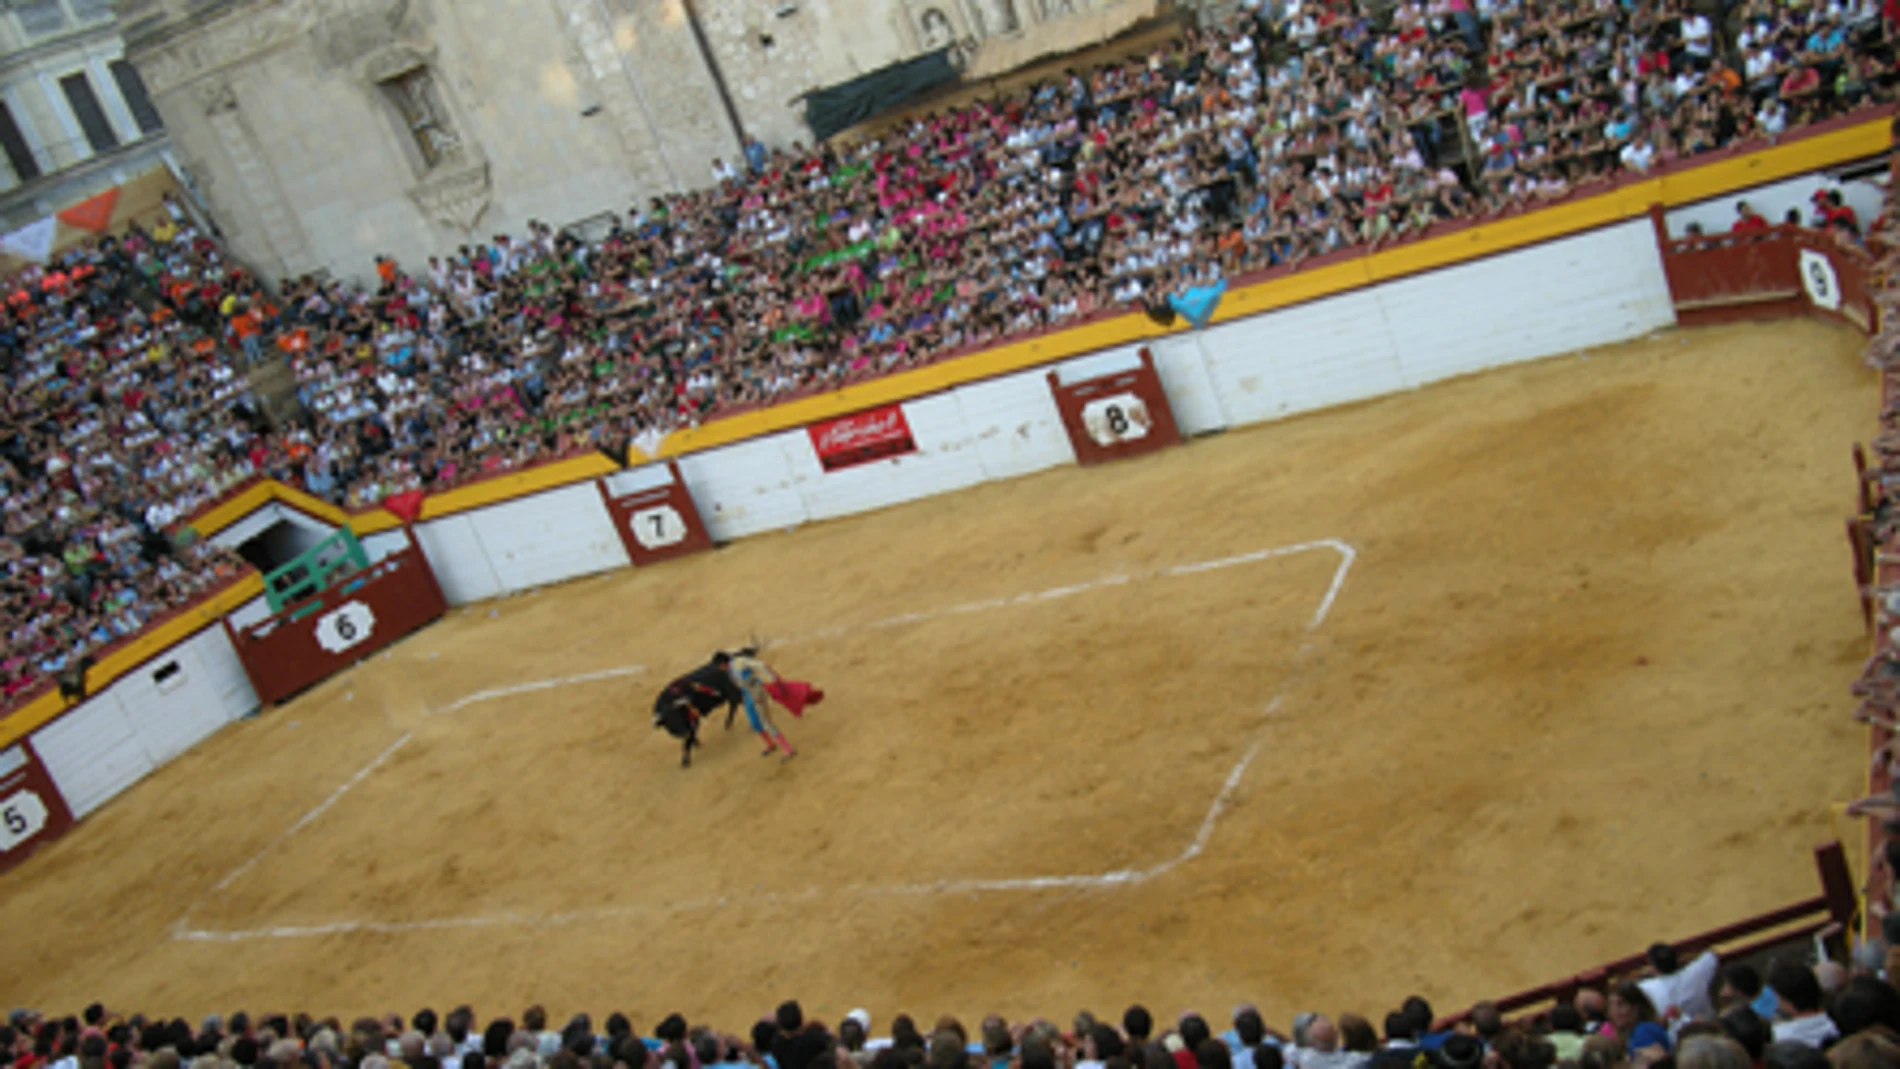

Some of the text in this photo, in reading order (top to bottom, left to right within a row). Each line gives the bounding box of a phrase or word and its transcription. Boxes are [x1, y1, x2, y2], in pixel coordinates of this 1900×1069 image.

[1809, 261, 1828, 297] 9
[1105, 404, 1129, 434] 8
[647, 514, 664, 537] 7
[335, 613, 357, 641] 6
[4, 805, 27, 834] 5
